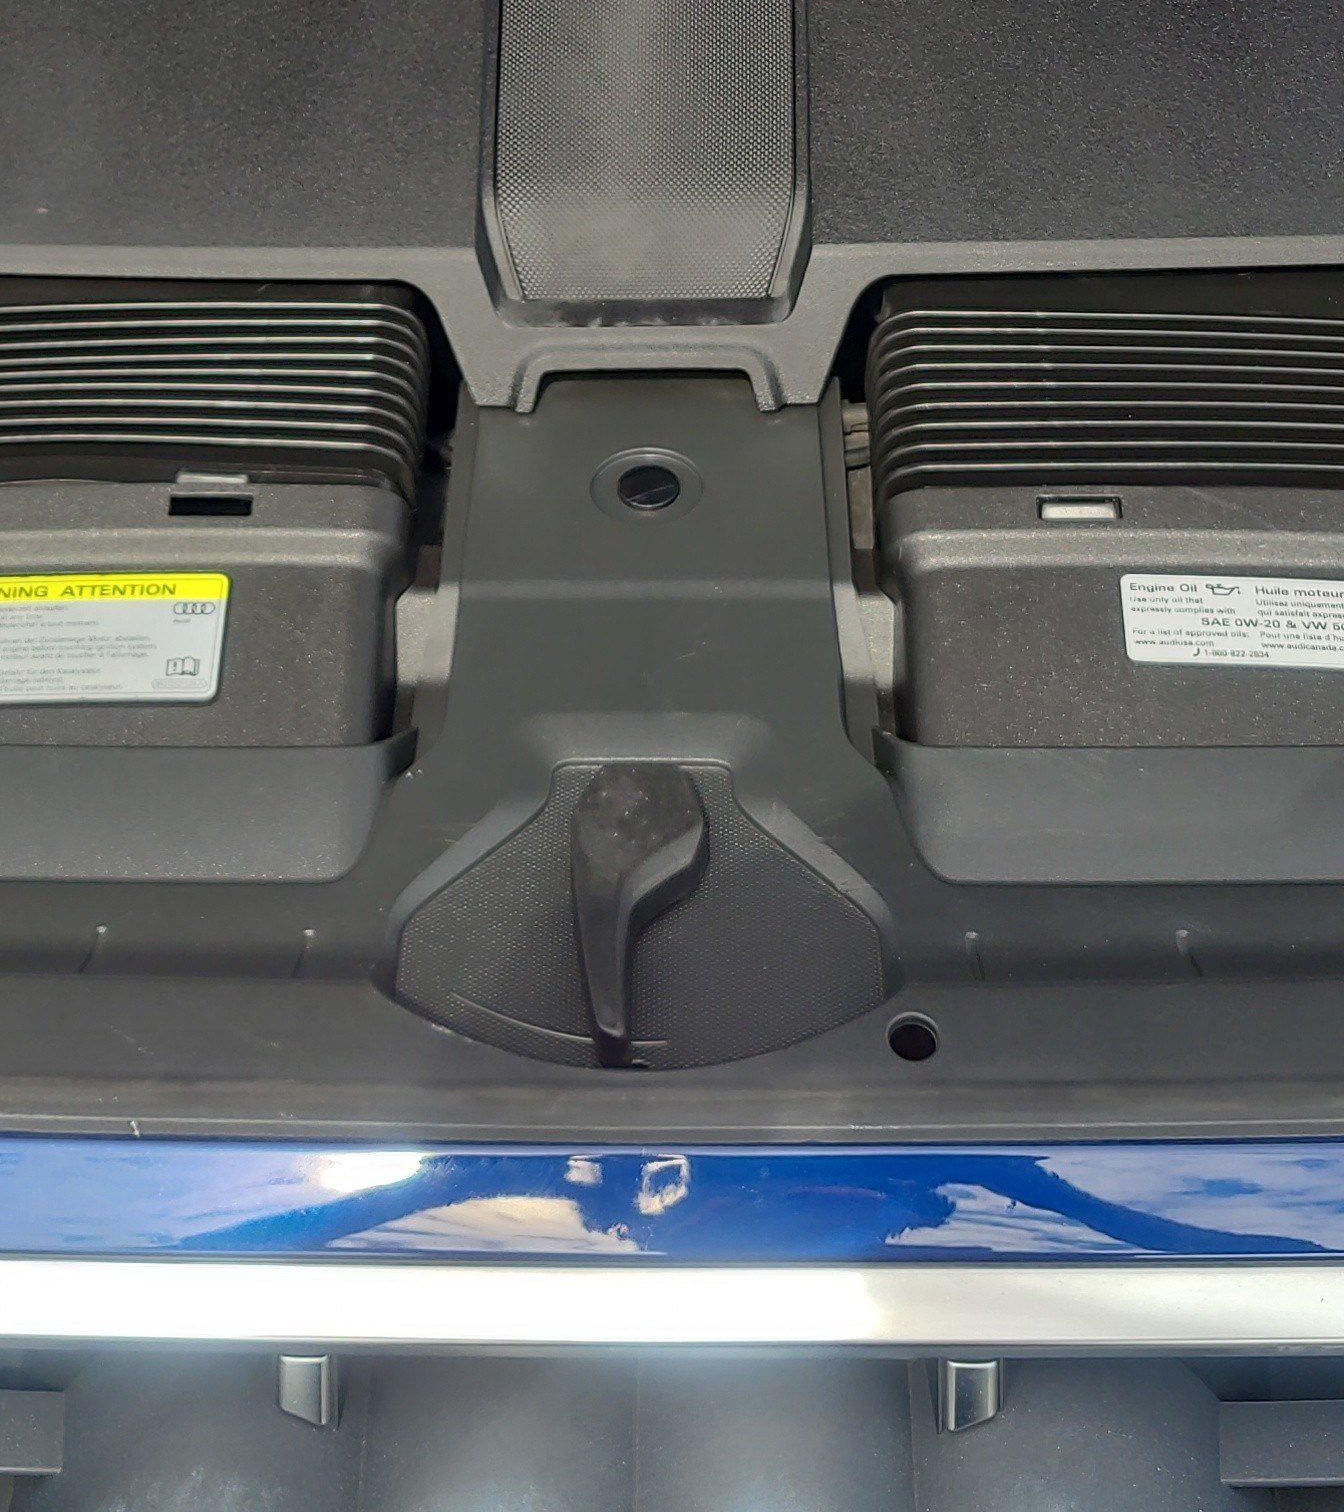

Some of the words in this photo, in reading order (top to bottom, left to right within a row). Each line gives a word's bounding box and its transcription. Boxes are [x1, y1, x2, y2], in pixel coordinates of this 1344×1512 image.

[60, 583, 177, 597] ATTENTION
[1130, 582, 1175, 593] Engine
[1180, 584, 1197, 592] Oil
[1255, 586, 1289, 596] Huile
[1294, 590, 1344, 599] moteur
[1256, 599, 1288, 607] Utilisez
[1291, 601, 1344, 610] uniquement
[1174, 607, 1214, 615] complies
[1257, 609, 1271, 617] qui
[1275, 610, 1309, 618] satisfait
[1201, 617, 1230, 626] SAE
[1235, 617, 1281, 629] 0W-20
[1286, 620, 1296, 629] &
[1302, 620, 1327, 630] VW
[1185, 629, 1228, 638] approved
